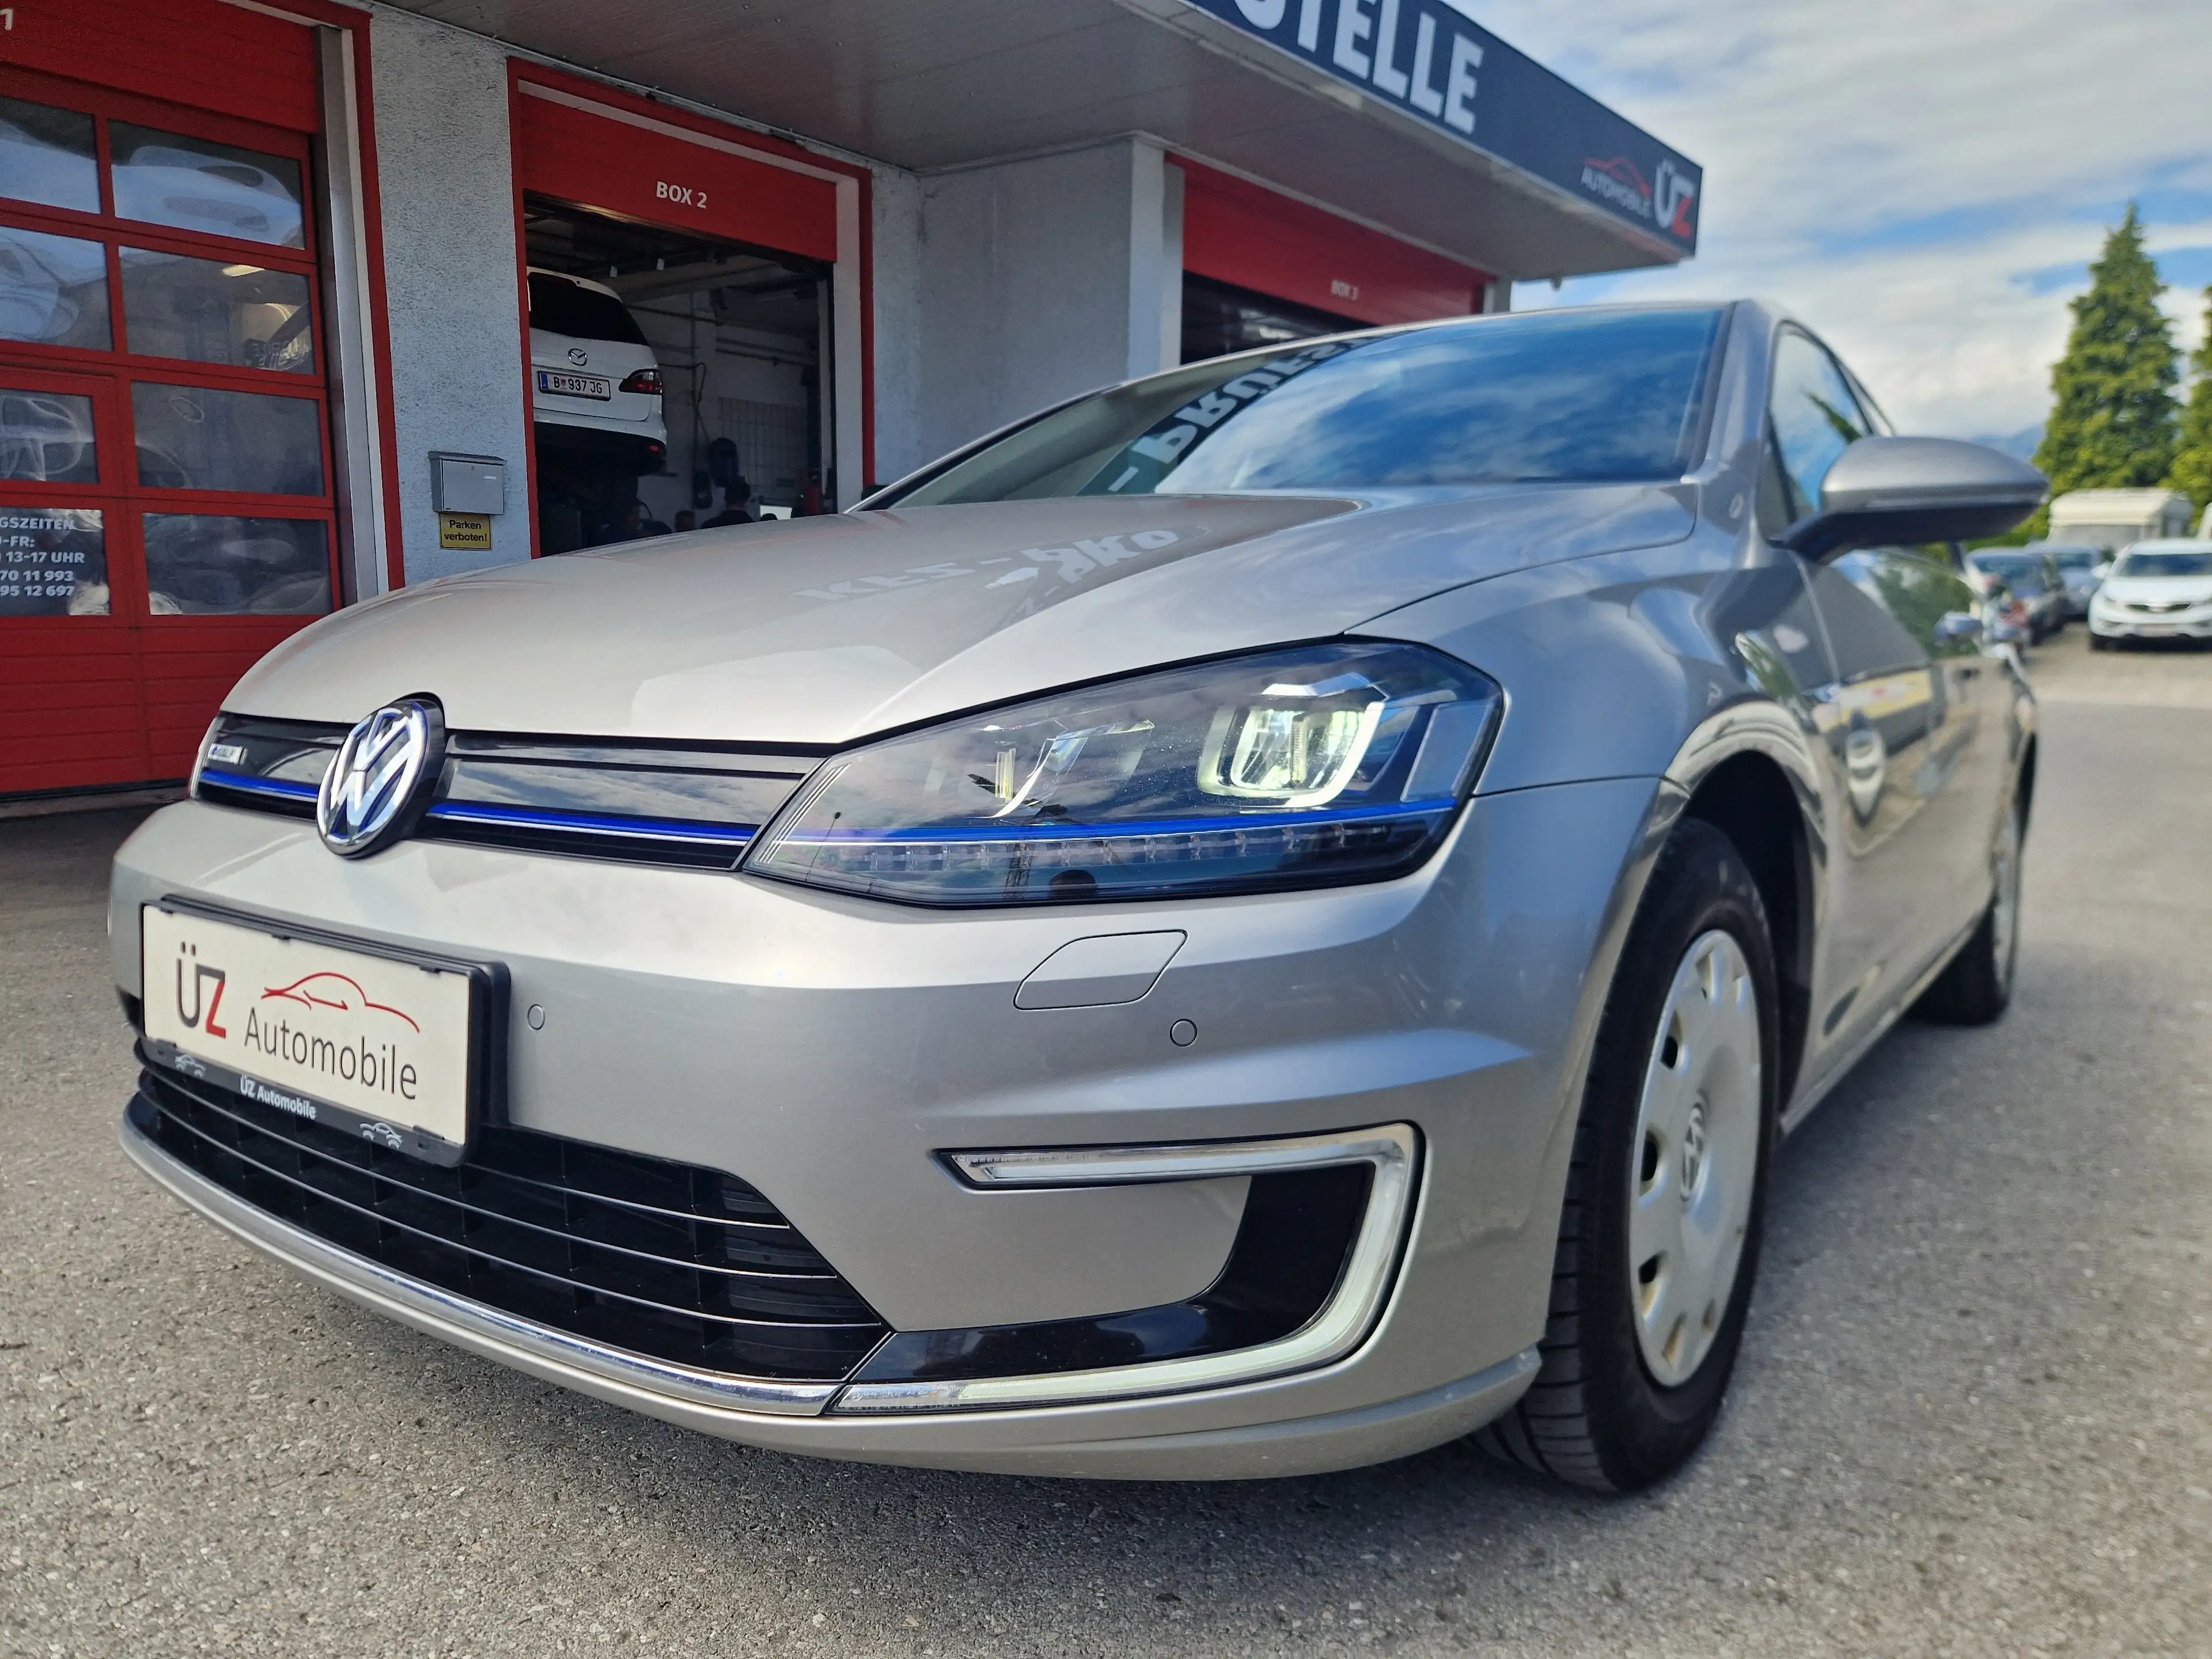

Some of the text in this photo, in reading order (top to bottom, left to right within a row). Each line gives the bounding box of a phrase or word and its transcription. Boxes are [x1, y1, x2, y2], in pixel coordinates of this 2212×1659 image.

[1234, 0, 1484, 135] ELLE
[656, 181, 707, 210] BOX 2
[554, 376, 603, 394] B 937 JG
[449, 520, 481, 529] Parken
[0, 536, 35, 547] -FR:
[444, 532, 487, 541] verboten!
[6, 551, 85, 563] 13-17 UHR
[22, 570, 40, 582] 11
[44, 570, 74, 582] 993
[24, 585, 43, 597] 12
[46, 585, 75, 597] 697
[176, 941, 226, 1039] ÜZ
[244, 1006, 417, 1100] Automobile
[240, 1074, 317, 1120] ÜZ Automobile
